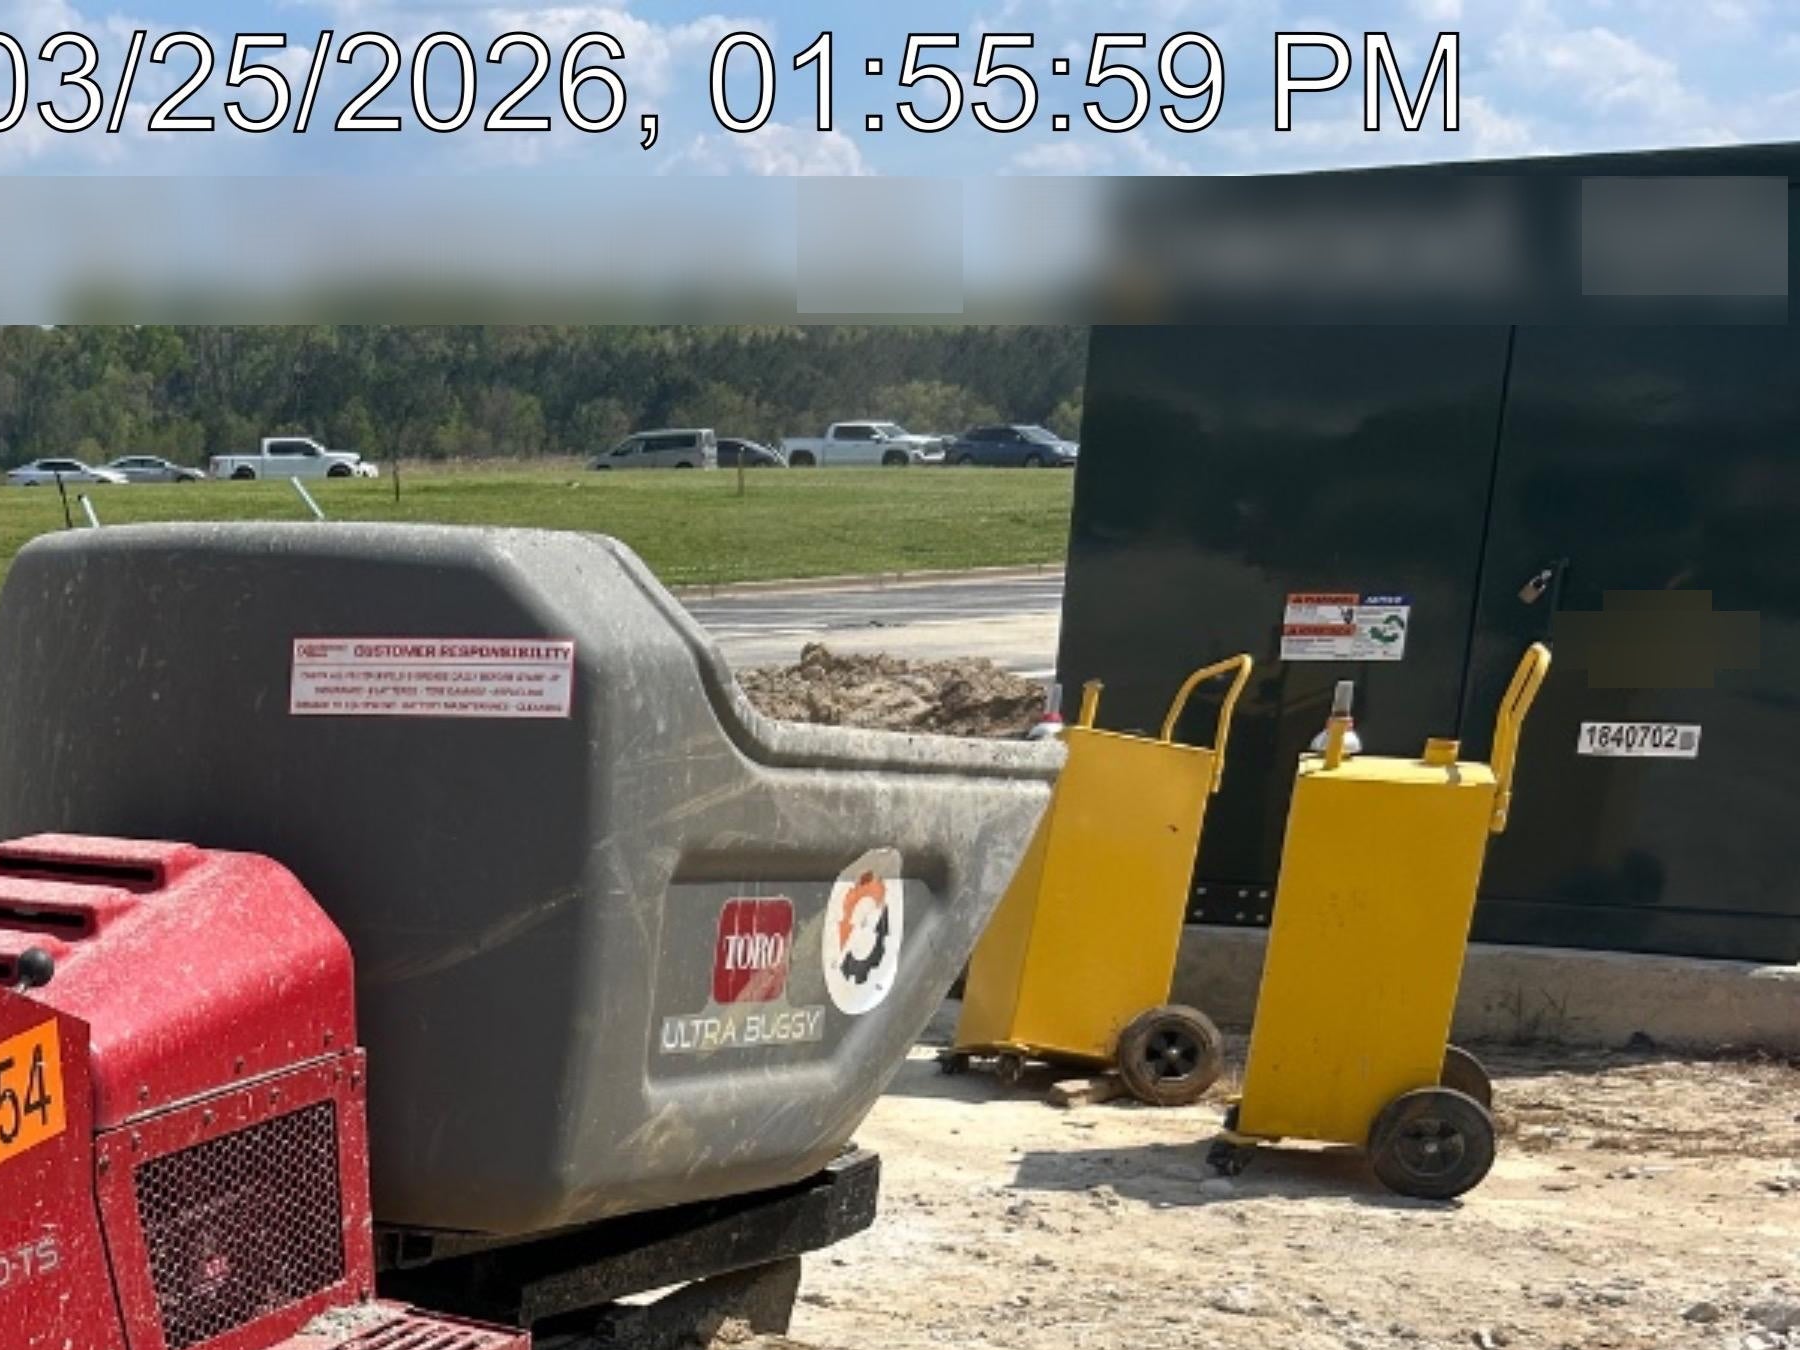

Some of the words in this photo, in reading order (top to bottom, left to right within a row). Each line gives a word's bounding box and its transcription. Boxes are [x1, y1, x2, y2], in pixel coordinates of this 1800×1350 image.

[354, 644, 436, 659] CUSTOMER
[440, 645, 571, 661] RESPONSIBILITY
[724, 931, 785, 970] TORO
[661, 1016, 737, 1049] ULTRA
